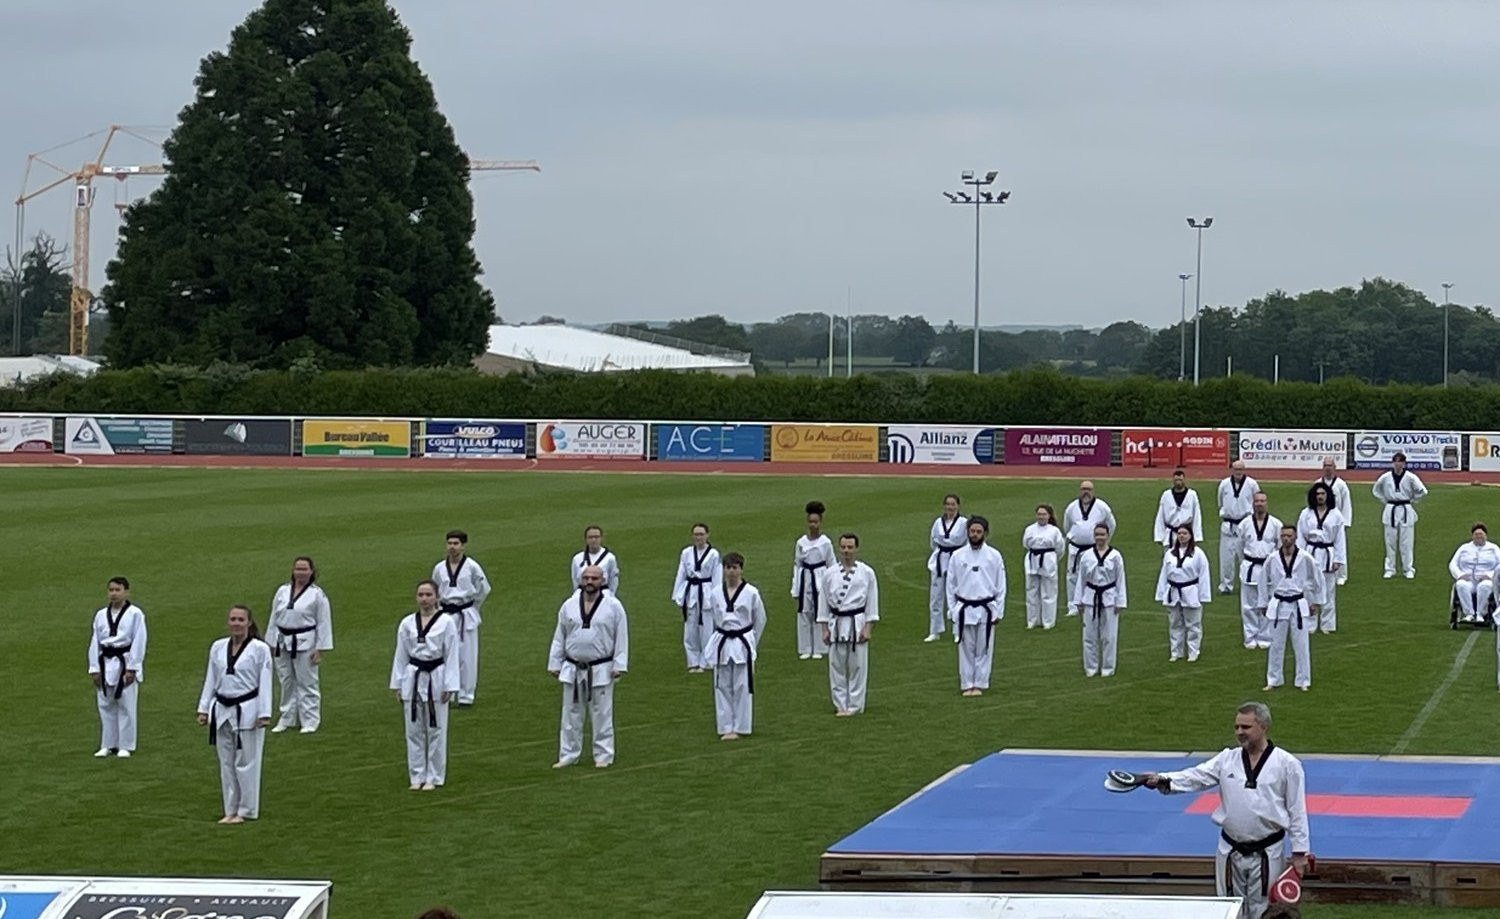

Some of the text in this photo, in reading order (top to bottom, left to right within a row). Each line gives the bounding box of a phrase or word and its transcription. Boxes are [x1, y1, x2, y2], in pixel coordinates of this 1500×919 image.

[578, 425, 636, 440] AUGER
[919, 431, 968, 445] Allianz
[428, 438, 524, 449] COURLLEAU PNEUS
[667, 426, 734, 453] ACE
[1240, 438, 1346, 451] Crédit Mutuel
[1382, 435, 1430, 444] VOLVO
[88, 896, 290, 906] BRESSUIRE AIRVAULT
